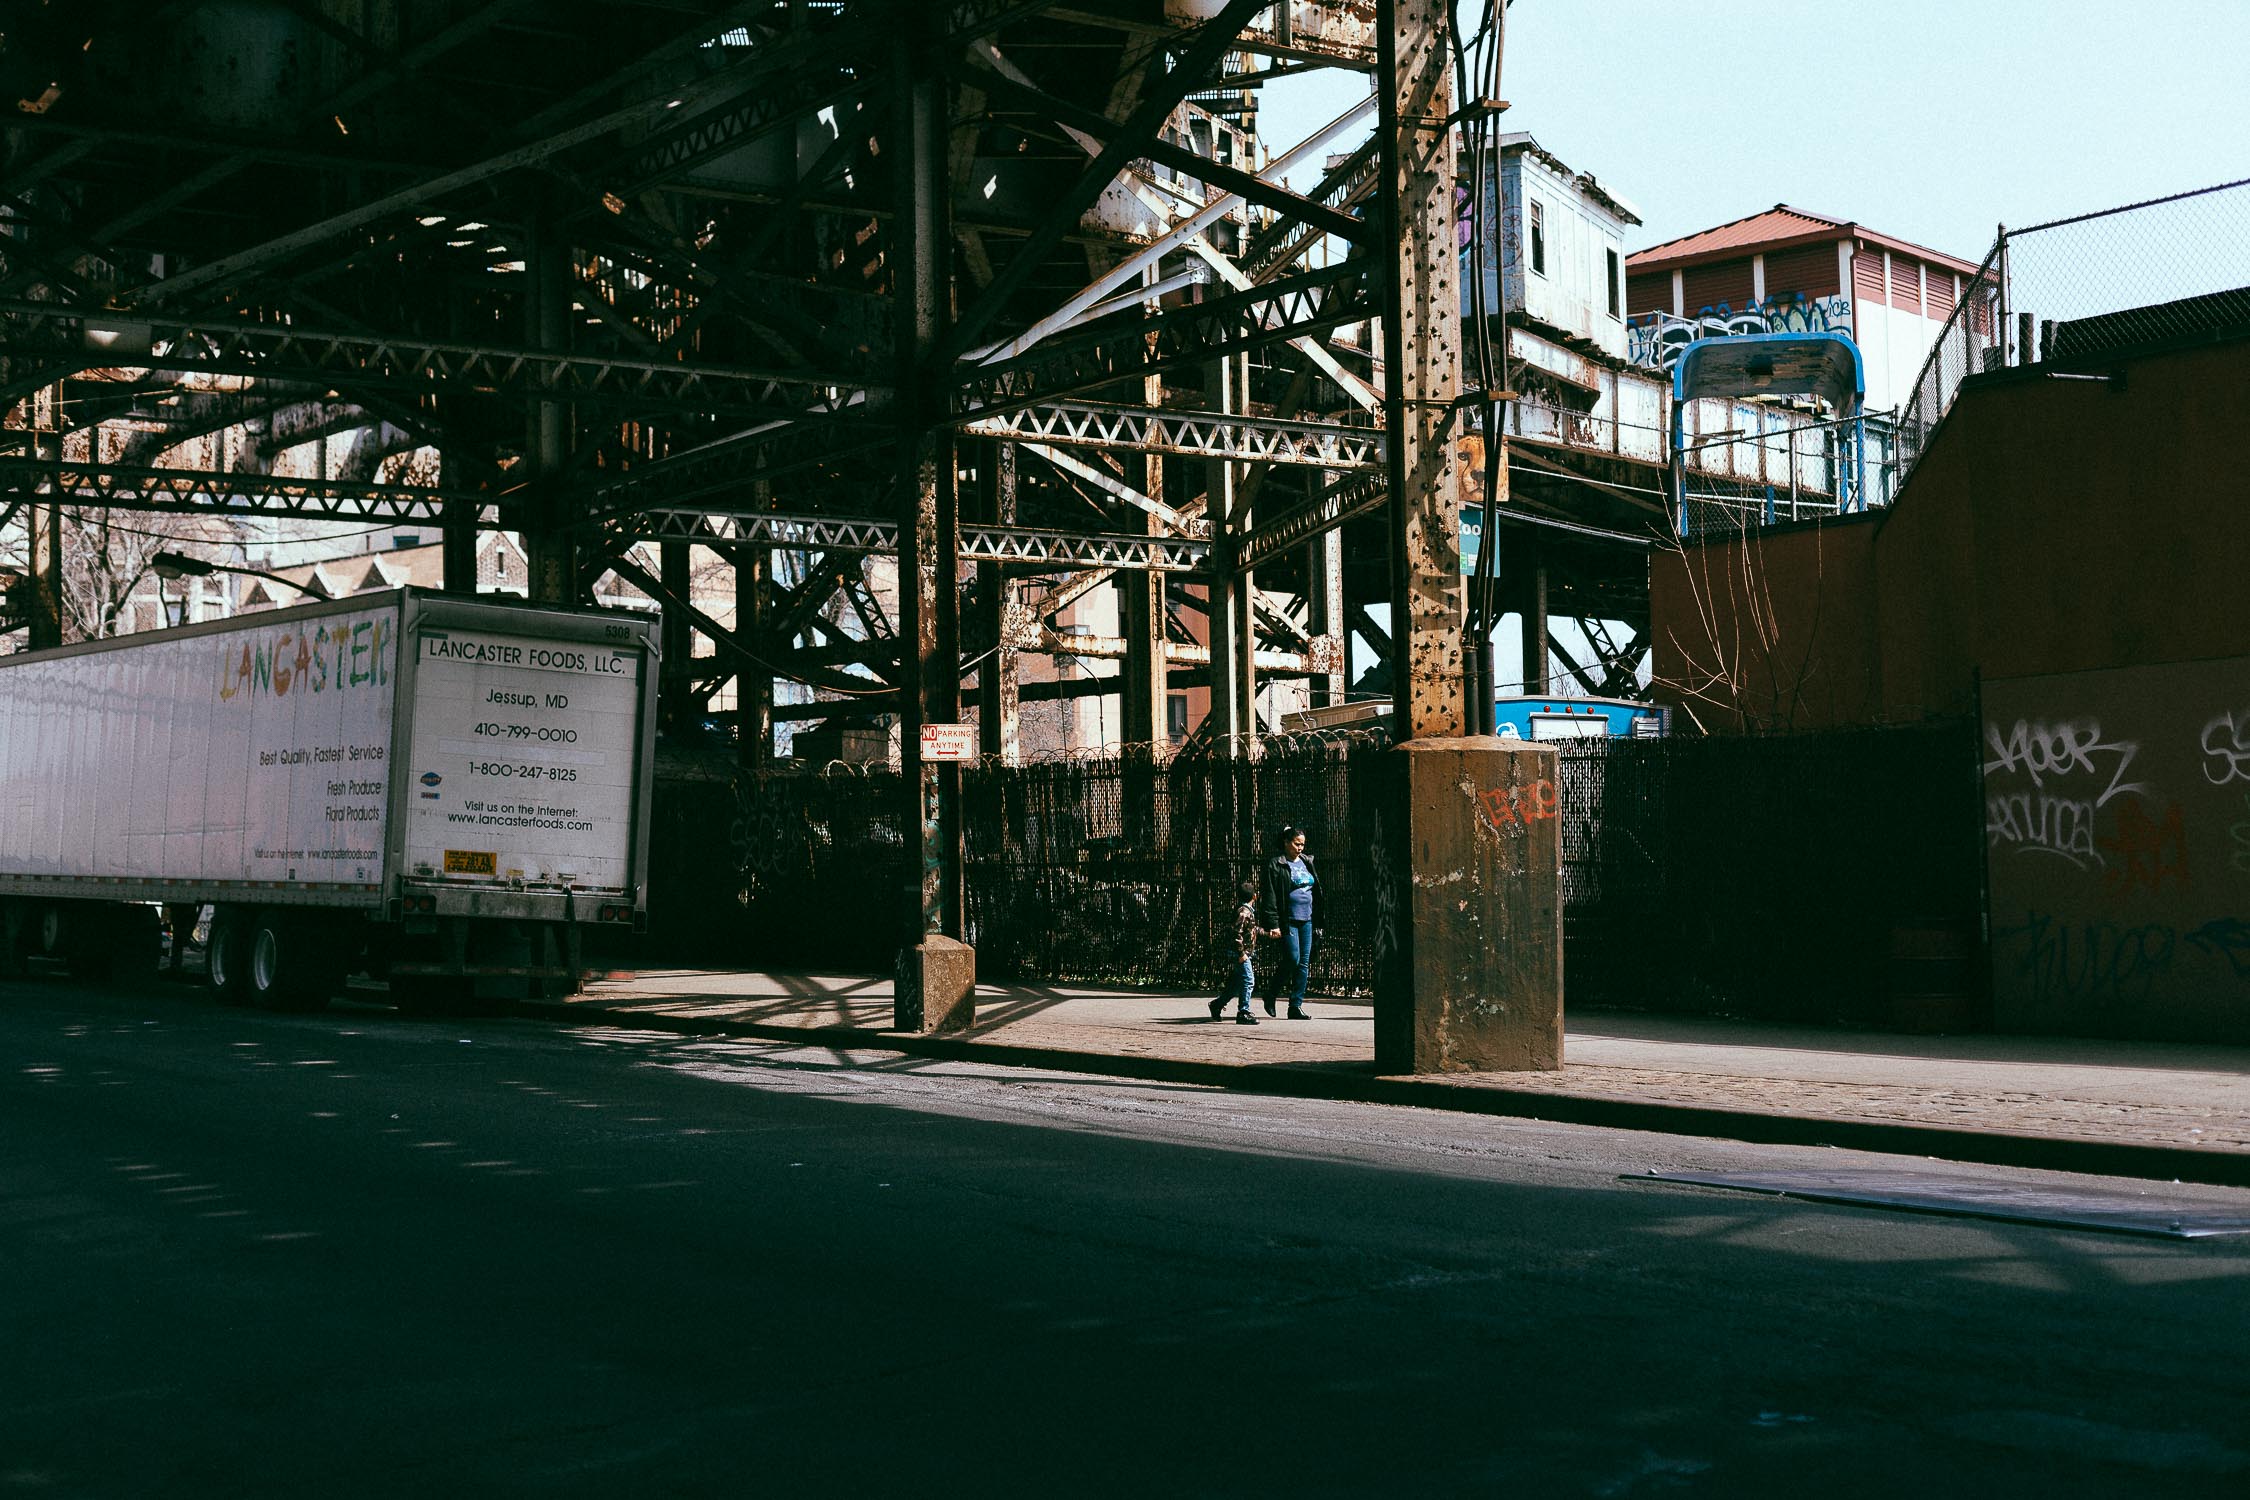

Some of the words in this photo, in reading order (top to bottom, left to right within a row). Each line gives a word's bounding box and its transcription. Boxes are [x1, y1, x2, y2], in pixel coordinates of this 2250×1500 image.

[605, 625, 630, 640] 5308
[220, 616, 390, 702] LANCASTER
[429, 640, 521, 665] LANCASTER
[529, 649, 588, 673] FOODS,
[594, 657, 625, 674] LLC.
[486, 689, 538, 709] Jessup,
[545, 694, 568, 709] MD
[474, 722, 577, 743] 410-799-0010
[922, 726, 937, 739] NO
[937, 730, 971, 738] PARKING
[259, 751, 277, 766] Best
[280, 749, 313, 767] Quality,
[314, 746, 345, 763] Fastest
[348, 744, 384, 761] Service
[469, 761, 577, 781] 1-800-247-8125
[327, 780, 346, 796] Fresh
[349, 779, 382, 796] Produce
[325, 806, 345, 822] Floral
[346, 805, 380, 821] Products
[465, 801, 484, 812] Visit
[487, 803, 498, 812] us
[501, 805, 515, 814] on
[518, 804, 534, 815] the
[537, 805, 578, 818] Internet:
[448, 813, 593, 831] www.lancasterfoods.com
